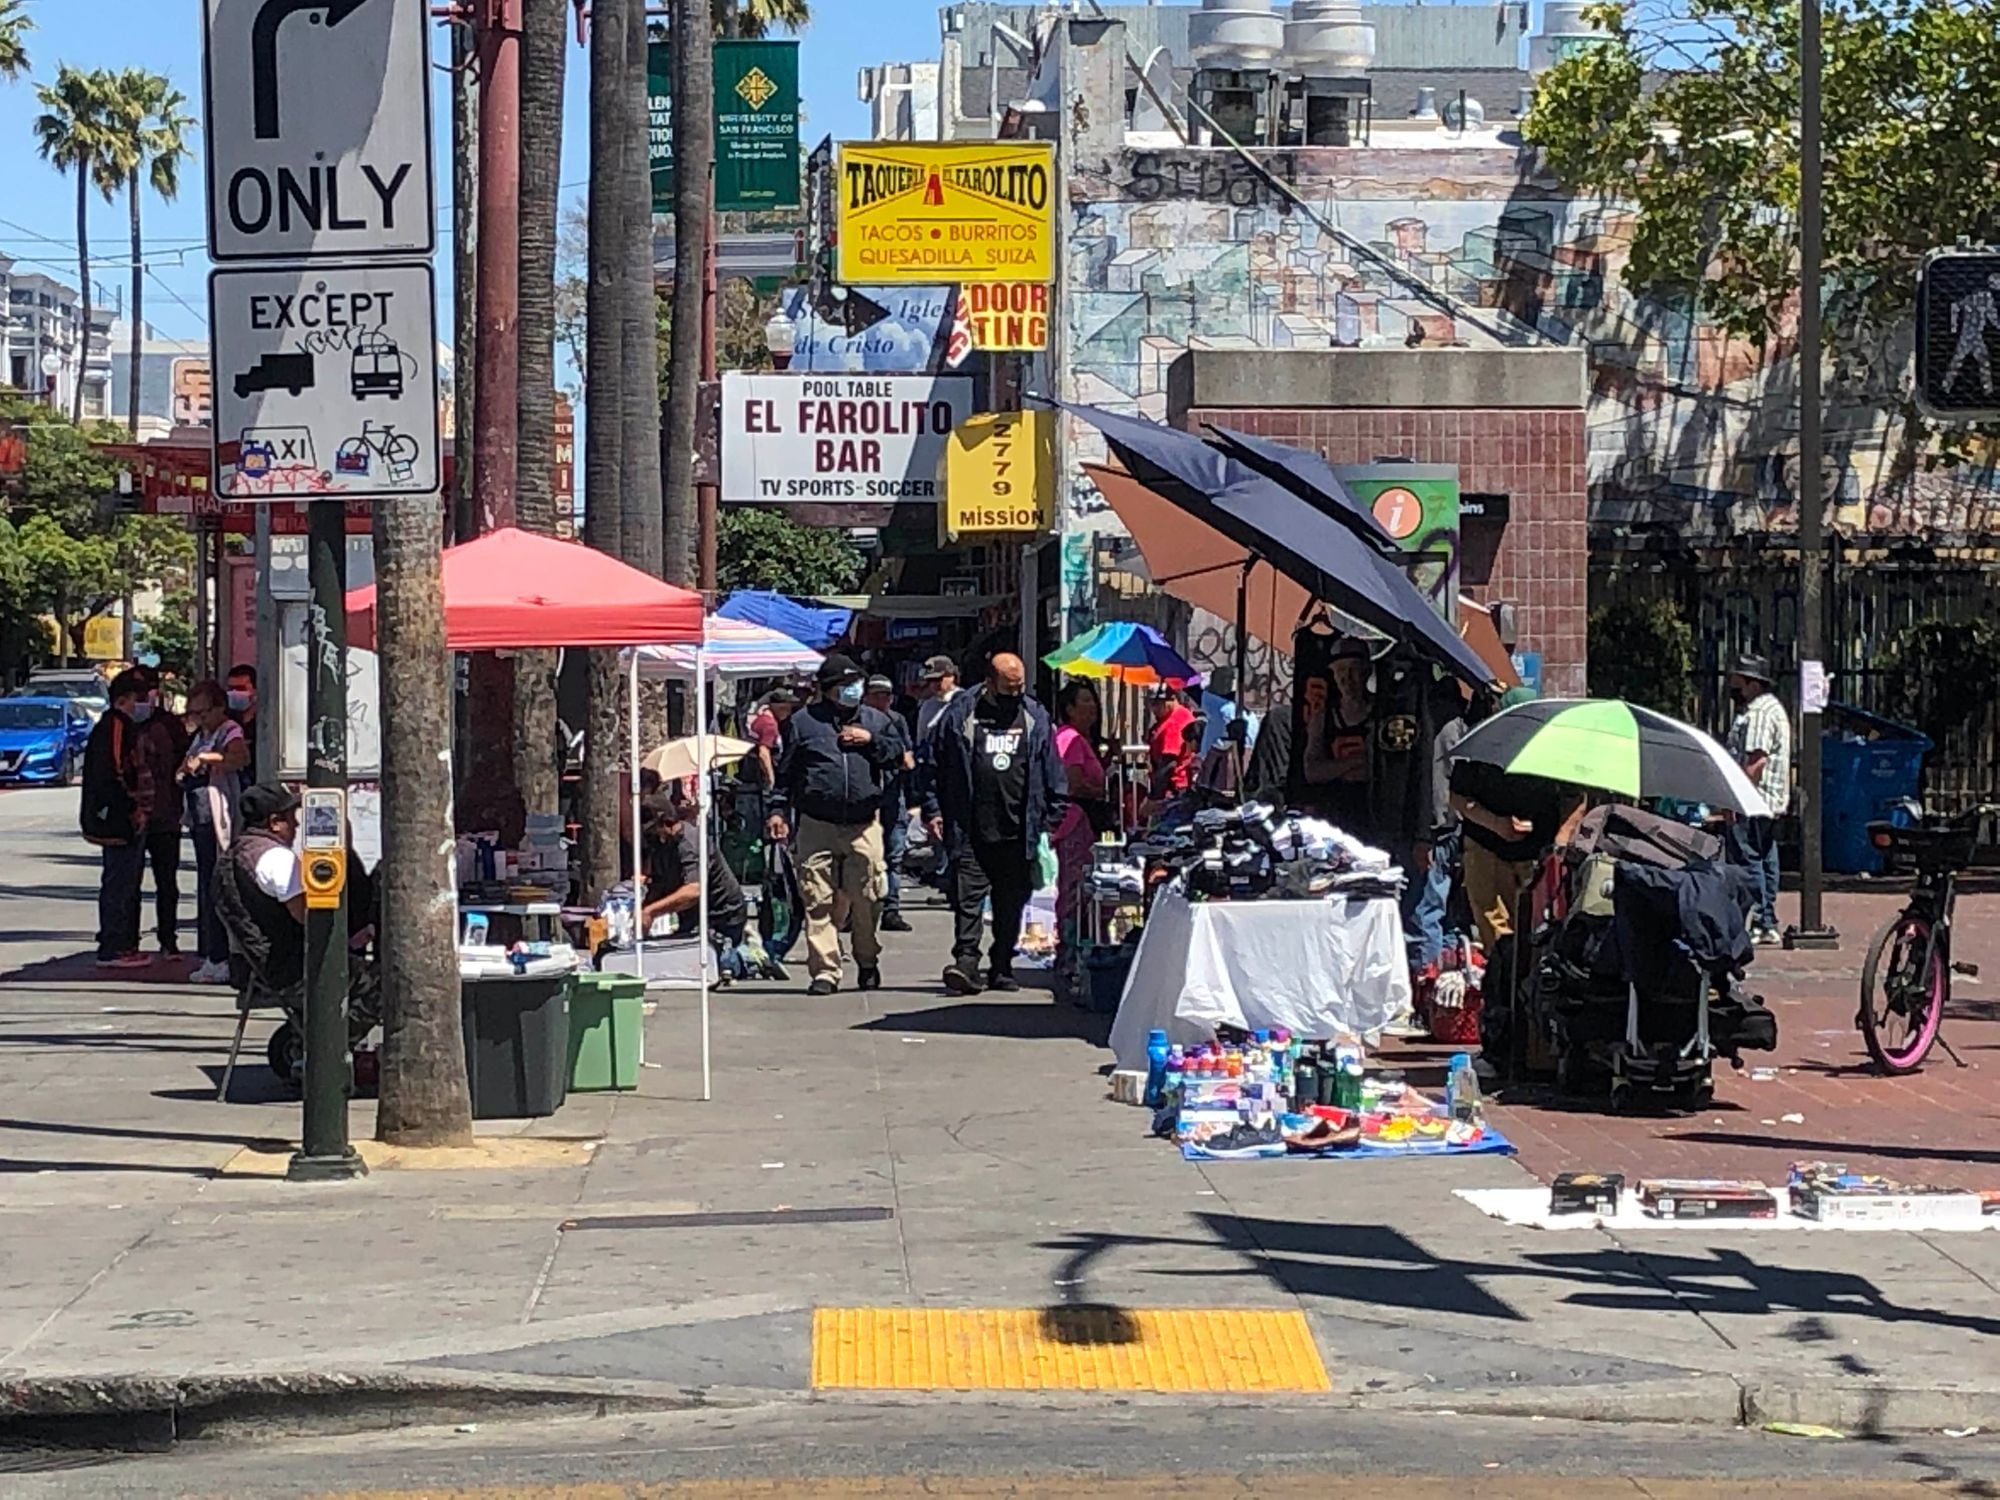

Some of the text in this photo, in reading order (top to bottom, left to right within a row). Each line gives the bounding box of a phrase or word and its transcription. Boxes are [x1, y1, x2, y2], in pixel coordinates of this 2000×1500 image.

[719, 114, 794, 123] UNIVERSITY OF
[719, 125, 794, 134] SAN FRANCISCO
[955, 163, 1048, 211] FAROLITO
[228, 163, 413, 235] ONLY
[860, 223, 1038, 241] TACOS BURRITOS
[859, 247, 1037, 266] QUESADILLA SUIZA
[970, 283, 1047, 314] DOOR
[250, 291, 394, 330] EXCEPT
[794, 334, 895, 355] de Cristo
[802, 380, 893, 397] POOL TABLE
[744, 399, 952, 435] EL FAROLITO
[244, 438, 306, 461] TAXI
[815, 439, 881, 473] BAR
[760, 479, 781, 496] TV
